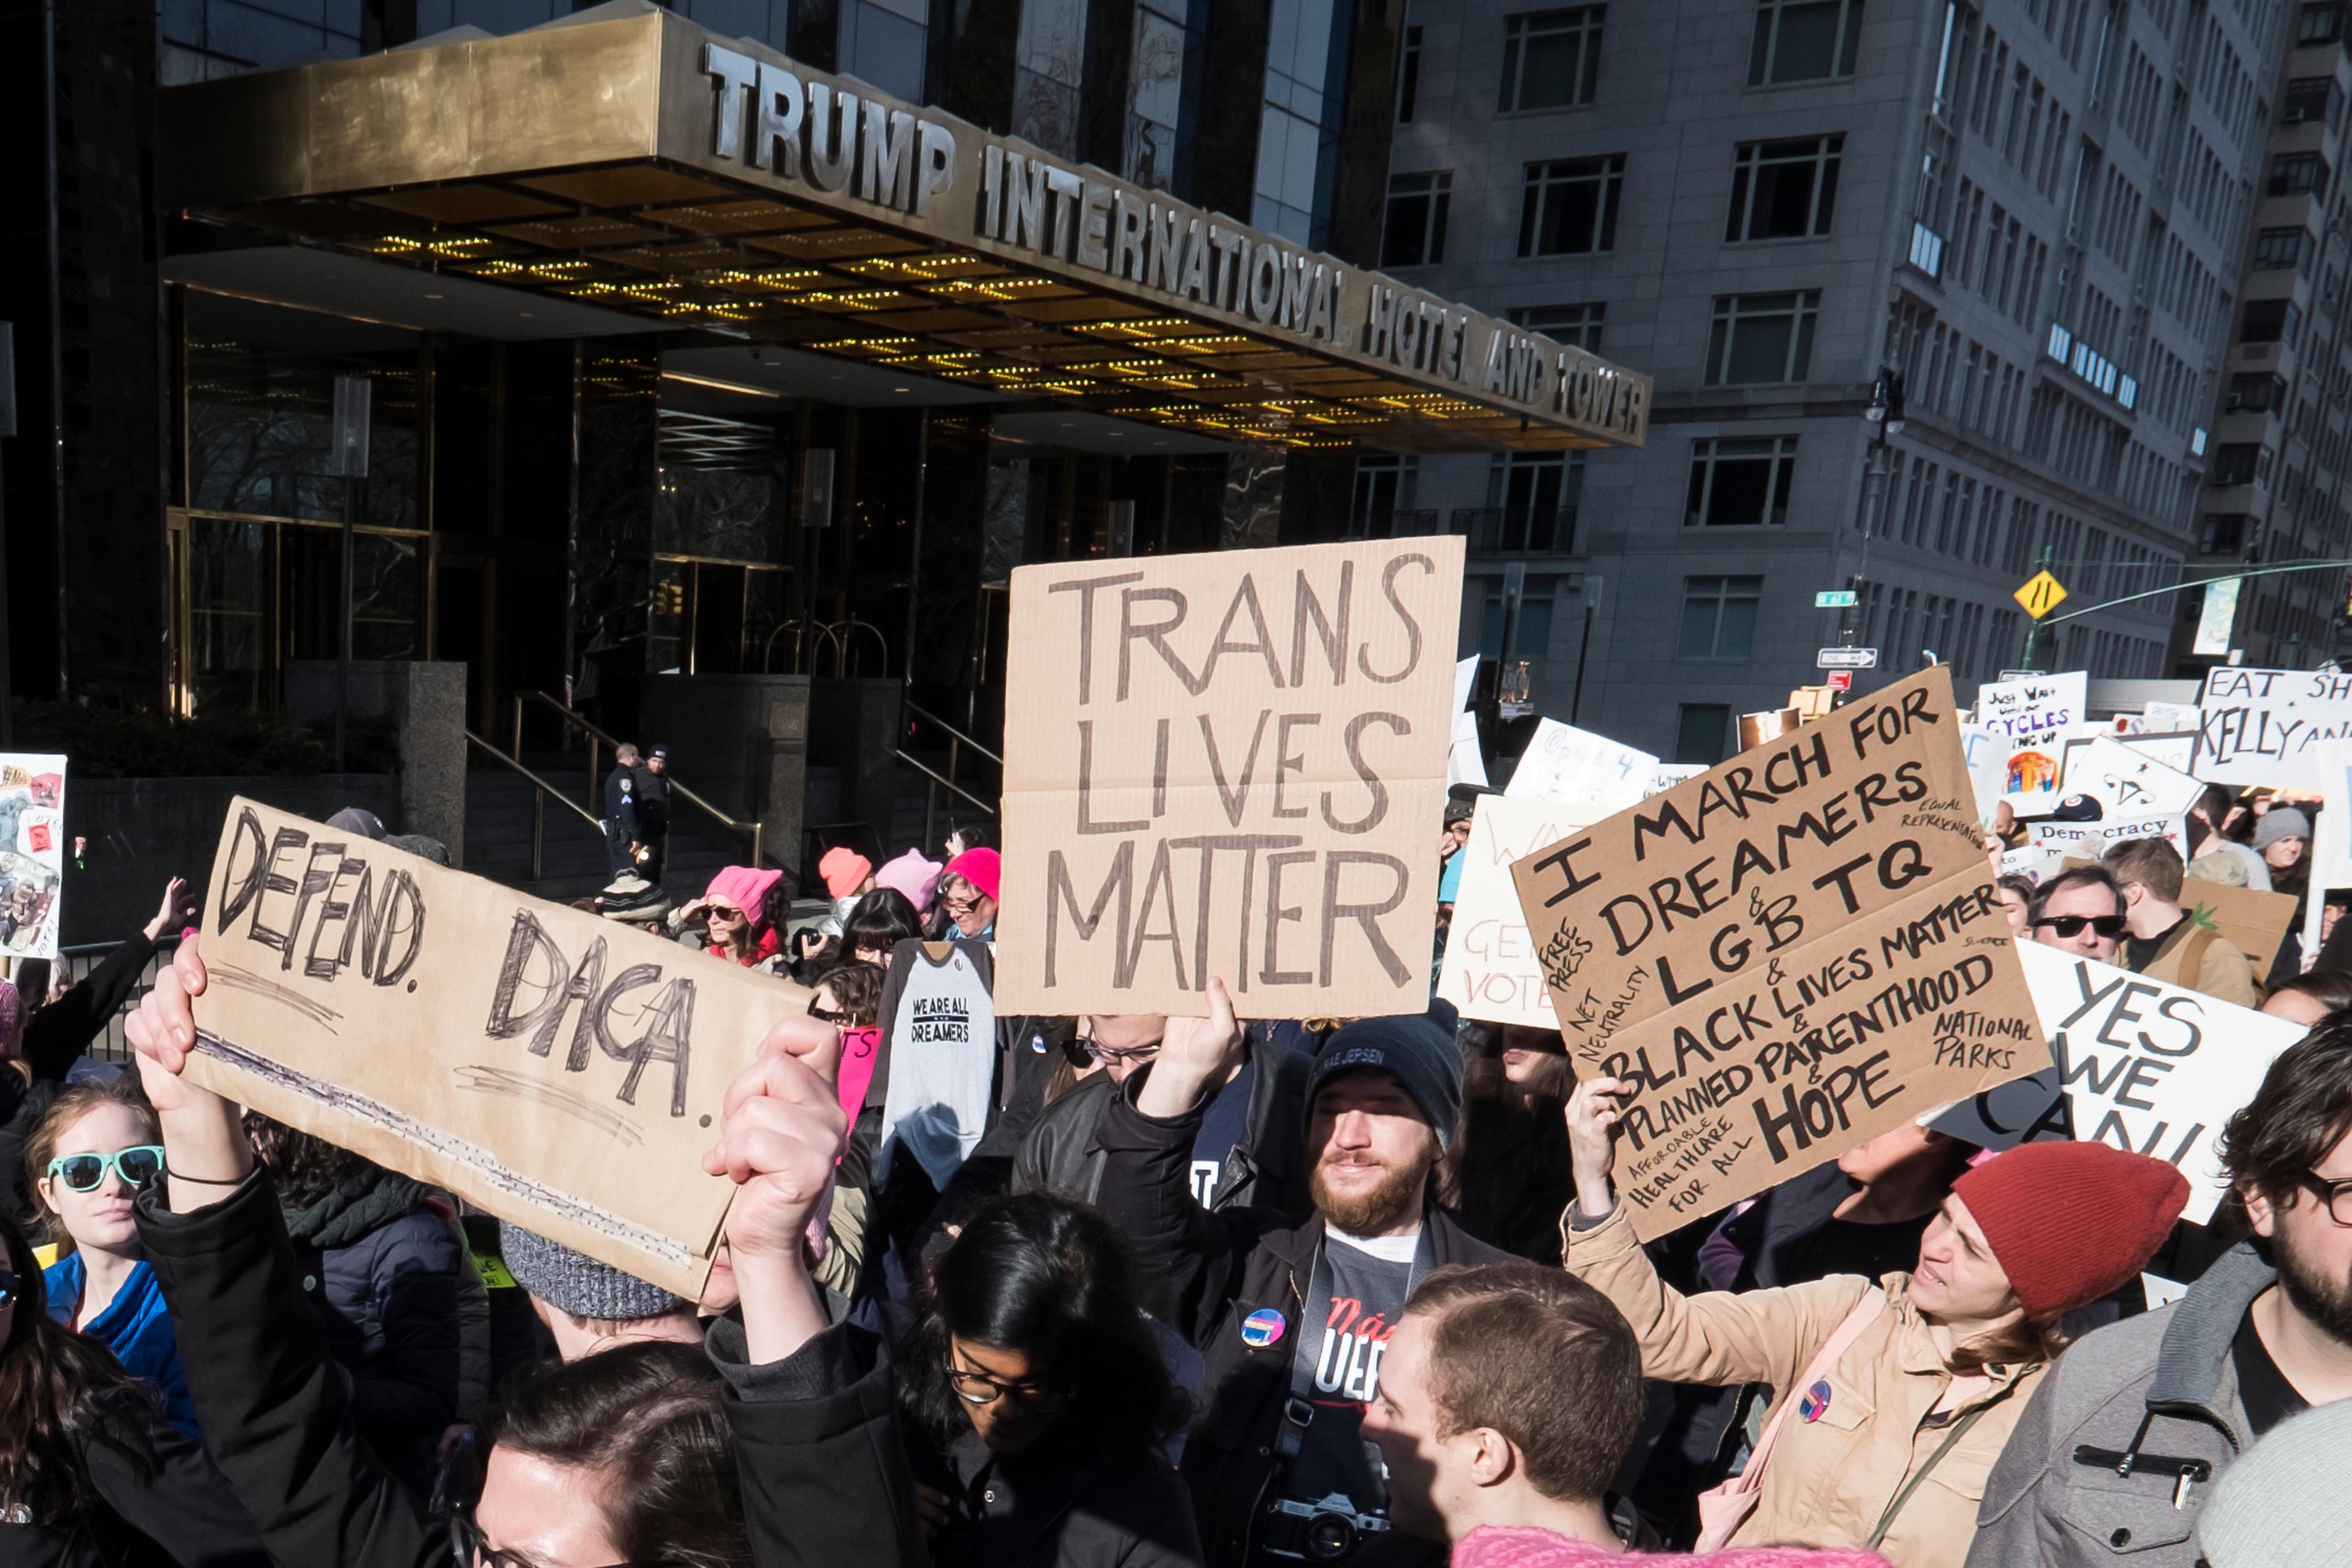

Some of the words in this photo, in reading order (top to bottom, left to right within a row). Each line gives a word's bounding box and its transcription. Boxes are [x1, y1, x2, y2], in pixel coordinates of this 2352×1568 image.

[705, 42, 957, 218] TRUMP
[980, 145, 1351, 347] INTERNATIONAL
[1367, 283, 1470, 384] HOTEL
[1482, 328, 1545, 404] AND
[1556, 352, 1646, 435] TOWER
[1048, 552, 1435, 705] TRANS
[2209, 669, 2285, 698] EAT
[1076, 708, 1411, 835] LIVES
[1533, 835, 1602, 909] I
[1633, 731, 1833, 862] MARCH
[1849, 687, 1939, 761] FOR
[1597, 760, 1928, 957] DREAMERS
[2039, 819, 2169, 840] Demcracy
[1044, 833, 1412, 993] MATTER
[1749, 886, 1765, 919] &
[1538, 916, 1578, 971] FREE
[1548, 940, 1594, 993] PRESS
[1766, 957, 1788, 987] &
[913, 997, 928, 1016] WE
[929, 997, 949, 1016] ARE
[952, 997, 970, 1015] ALL
[1570, 987, 1604, 1033] NET
[1579, 965, 1651, 1063] NEUTRALITY
[1599, 994, 1773, 1111] BLACK
[1773, 947, 1874, 1020] LIVES
[1880, 883, 2010, 970] MATTER
[1793, 1012, 1811, 1035] &
[1932, 1011, 2034, 1042] NATIONAL
[2059, 960, 2204, 1057] YES
[911, 1022, 970, 1043] DREAMERS
[1341, 1047, 1385, 1066] JEPSEN
[1619, 1063, 1755, 1153] PLANNED
[1754, 954, 1995, 1087] PARENTHOOD
[1932, 1035, 2017, 1071] PARKS
[1807, 1062, 1825, 1085] &
[2056, 1031, 2175, 1112] WE
[1751, 1050, 1906, 1165] HOPE
[1627, 1116, 1713, 1182] AFFORDABLE
[1627, 1114, 1733, 1211] HEALTHCARE
[1667, 1178, 1709, 1214] FOR
[1711, 1135, 1754, 1178] ALL
